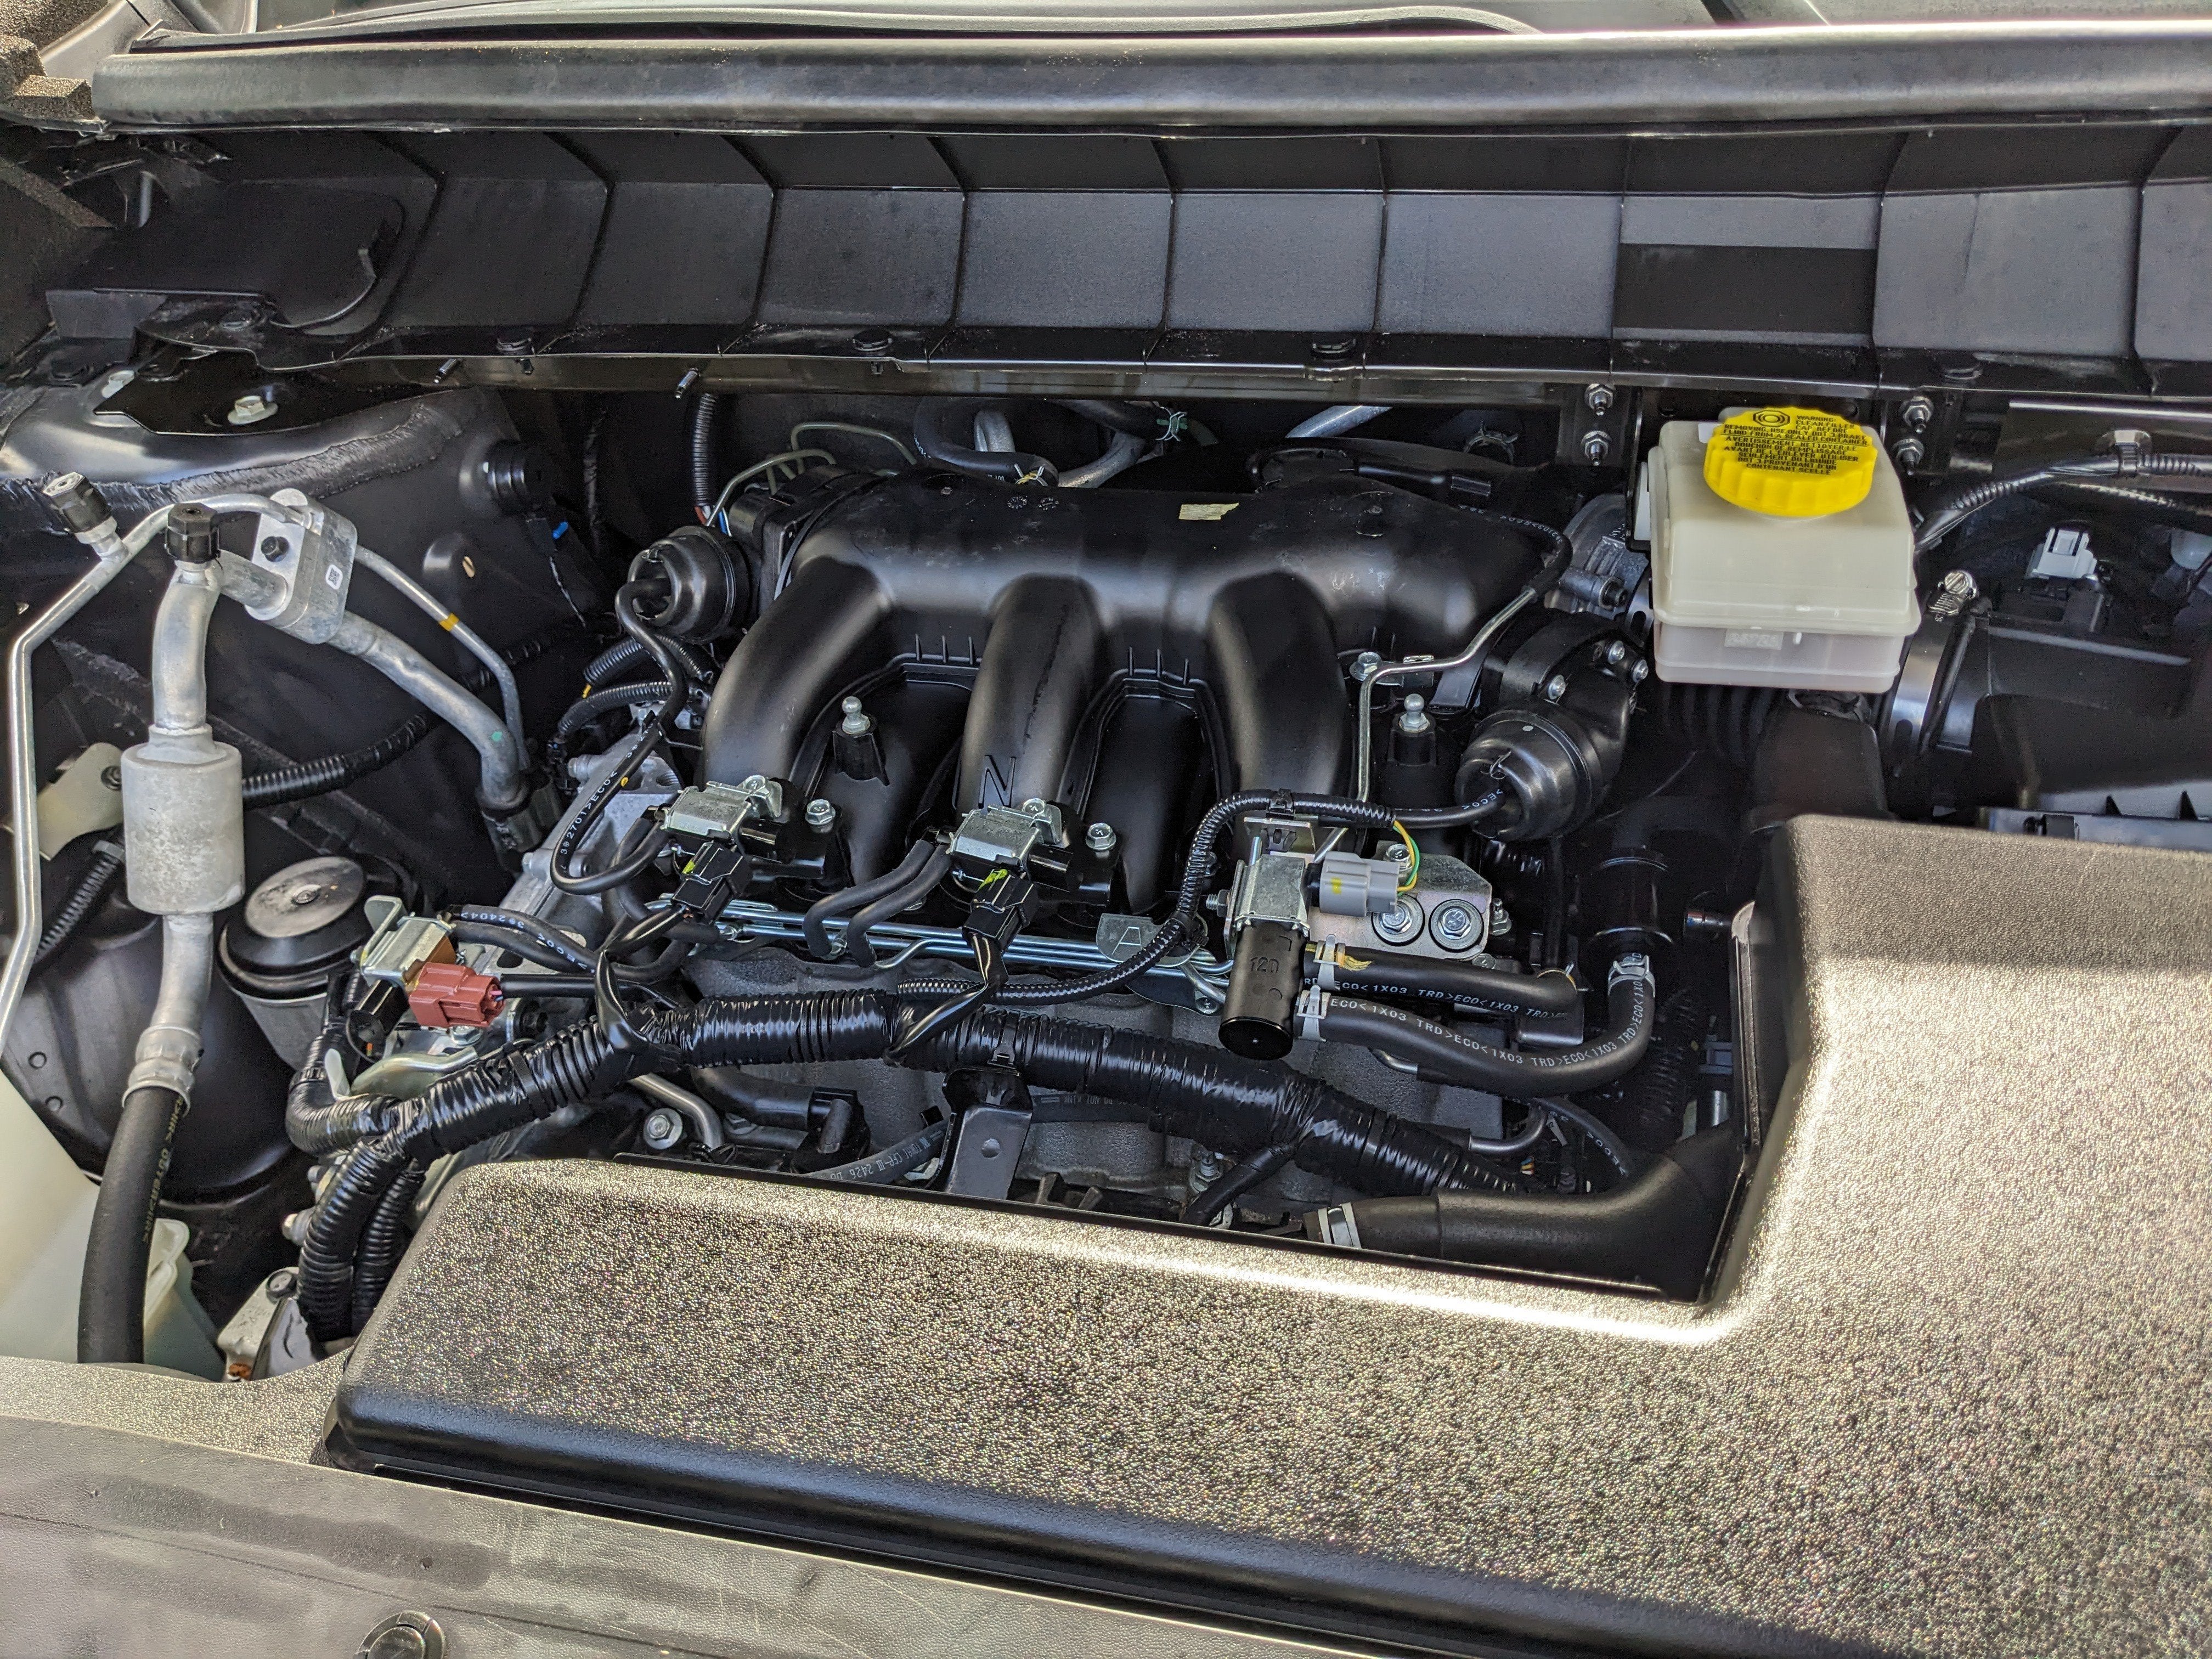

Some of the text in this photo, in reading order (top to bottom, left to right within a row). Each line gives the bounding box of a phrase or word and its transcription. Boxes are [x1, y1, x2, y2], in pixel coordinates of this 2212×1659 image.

[1787, 446, 1847, 455] REMPLISSAGE
[1739, 452, 1787, 460] SEULEMENT
[1746, 464, 1795, 472] CONTENANT
[1764, 460, 1814, 468] PROVENANT
[978, 754, 1016, 809] N
[850, 1163, 874, 1180] 2426
